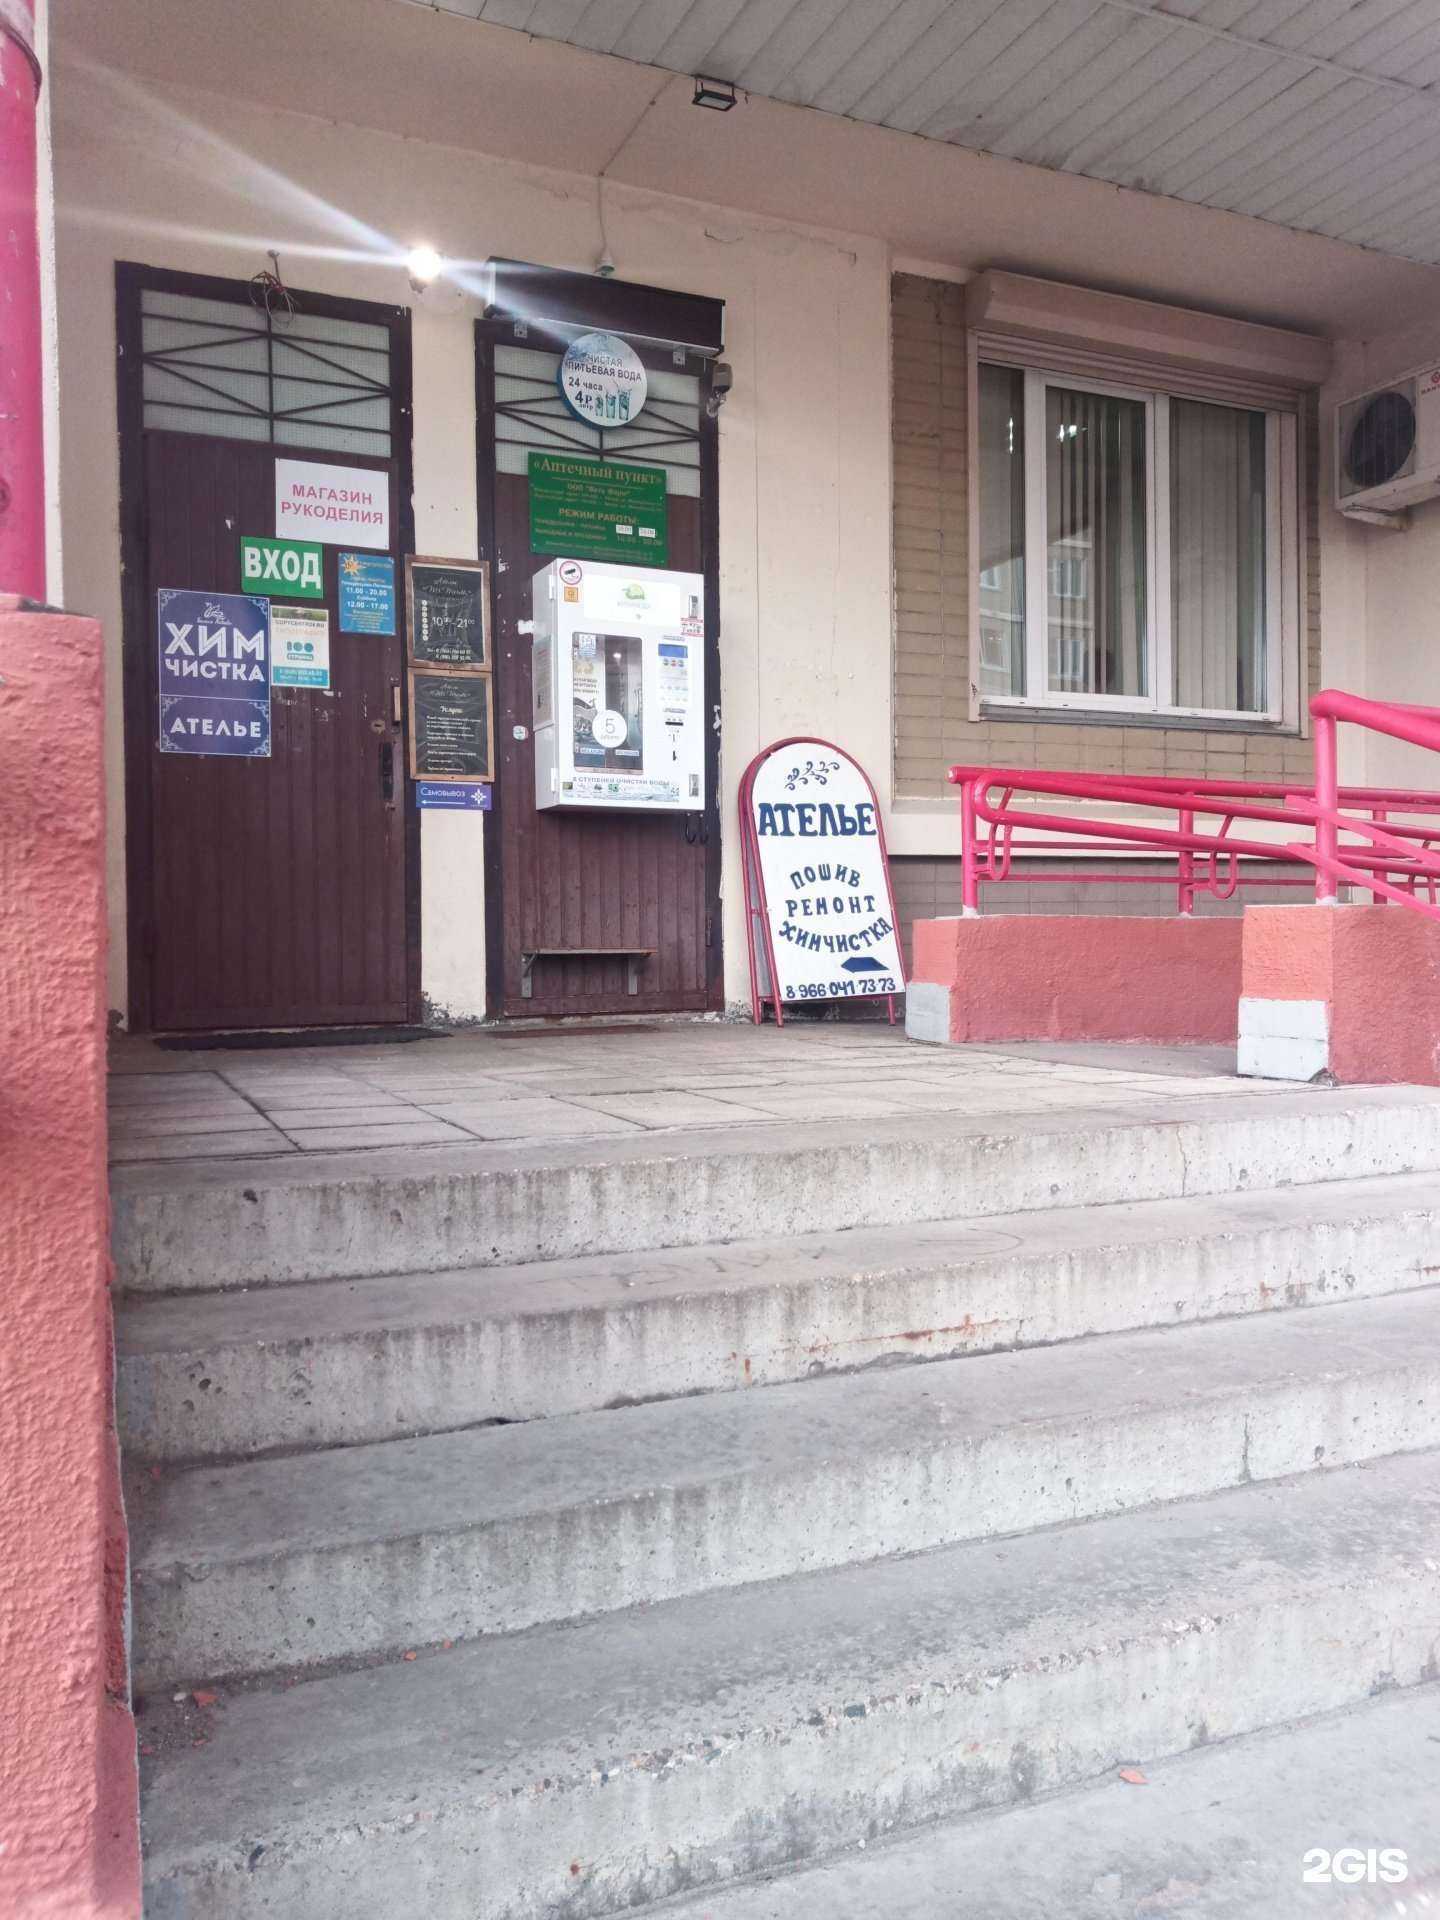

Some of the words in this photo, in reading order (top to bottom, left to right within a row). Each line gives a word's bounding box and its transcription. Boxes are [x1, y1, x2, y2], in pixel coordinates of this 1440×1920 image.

[569, 377, 580, 387] 24
[582, 382, 603, 391] часа
[617, 370, 641, 381] ВОДА
[534, 458, 612, 478] «Аптечный
[292, 484, 372, 504] МАГАЗИН
[281, 501, 383, 525] РУКОДЕЛИЯ
[559, 508, 594, 519] РЕЖИМ
[244, 547, 321, 590] ВХОД
[164, 622, 265, 660] ХИМ
[165, 658, 266, 682] ЧИСТКА
[170, 717, 262, 738] АТЕЛЬЕ
[605, 718, 615, 734] 5
[758, 802, 877, 837] АТЕЛЬЕ
[790, 863, 860, 890] ПОШИВ
[785, 895, 876, 918] РЕМОНТ
[778, 917, 894, 953] ХИМЧИСТКА
